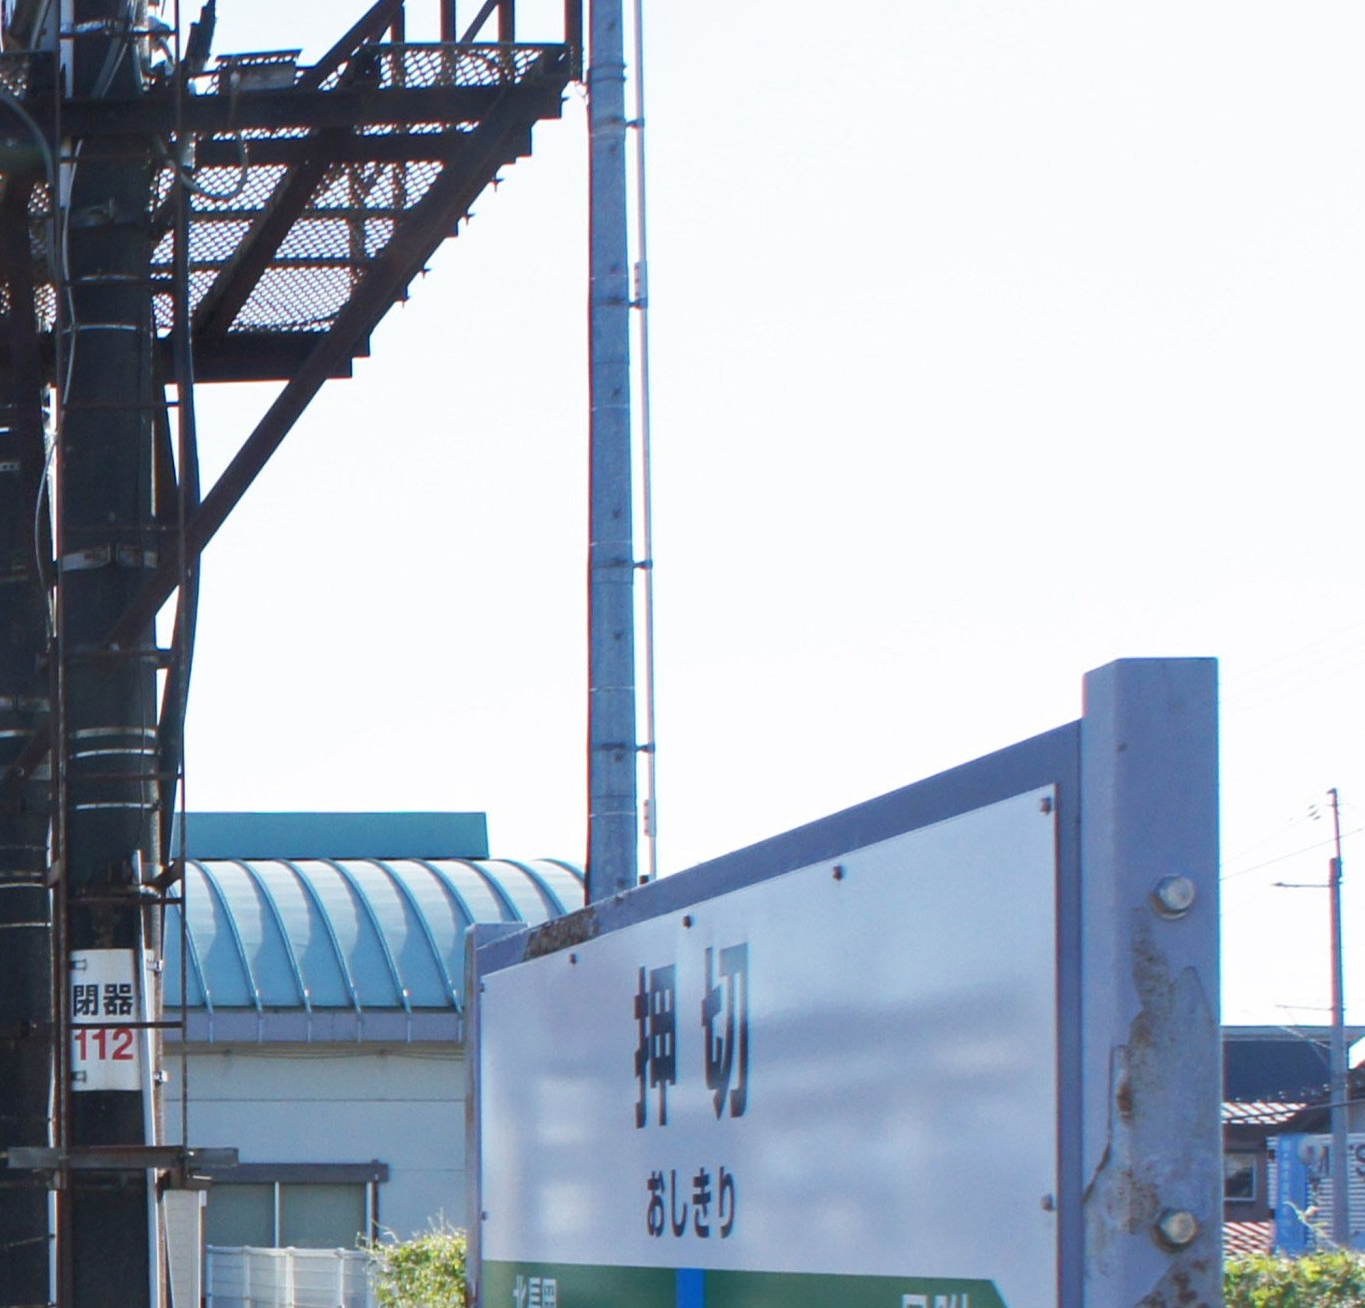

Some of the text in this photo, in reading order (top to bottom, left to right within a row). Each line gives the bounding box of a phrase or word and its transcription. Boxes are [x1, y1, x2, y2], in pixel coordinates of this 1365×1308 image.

[74, 1026, 134, 1061] 112
[634, 942, 748, 1128] 押切
[647, 1166, 735, 1238] おしきり
